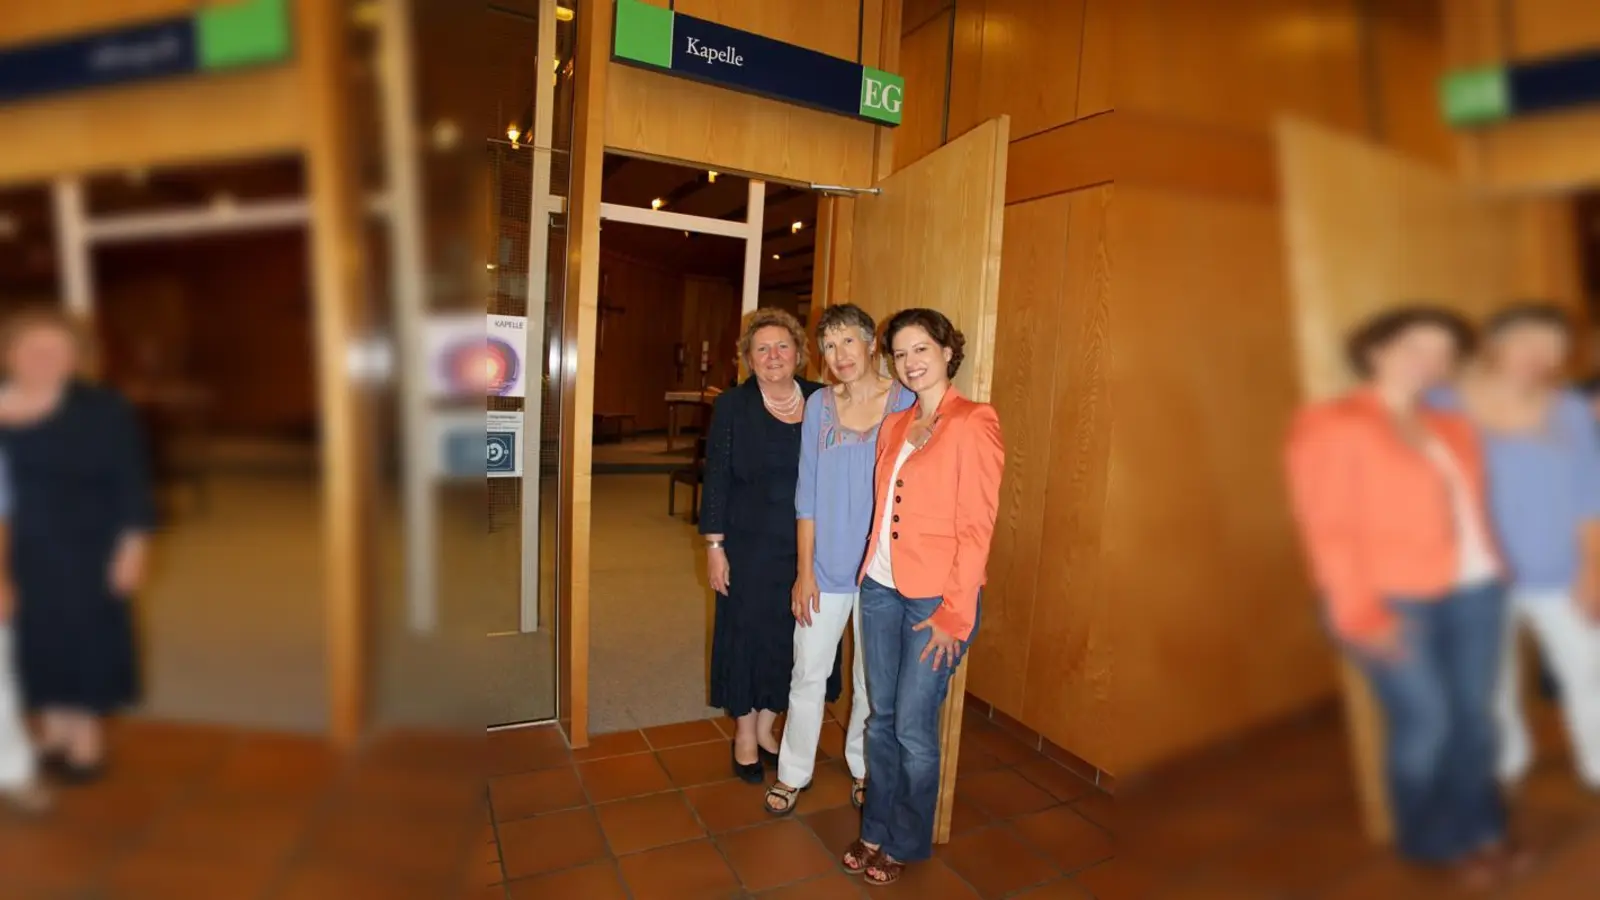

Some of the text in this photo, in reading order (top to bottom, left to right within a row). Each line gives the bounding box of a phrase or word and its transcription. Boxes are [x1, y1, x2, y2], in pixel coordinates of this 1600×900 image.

[686, 37, 743, 67] Kapelle
[864, 78, 902, 113] EG
[494, 320, 523, 330] KAPELLE
